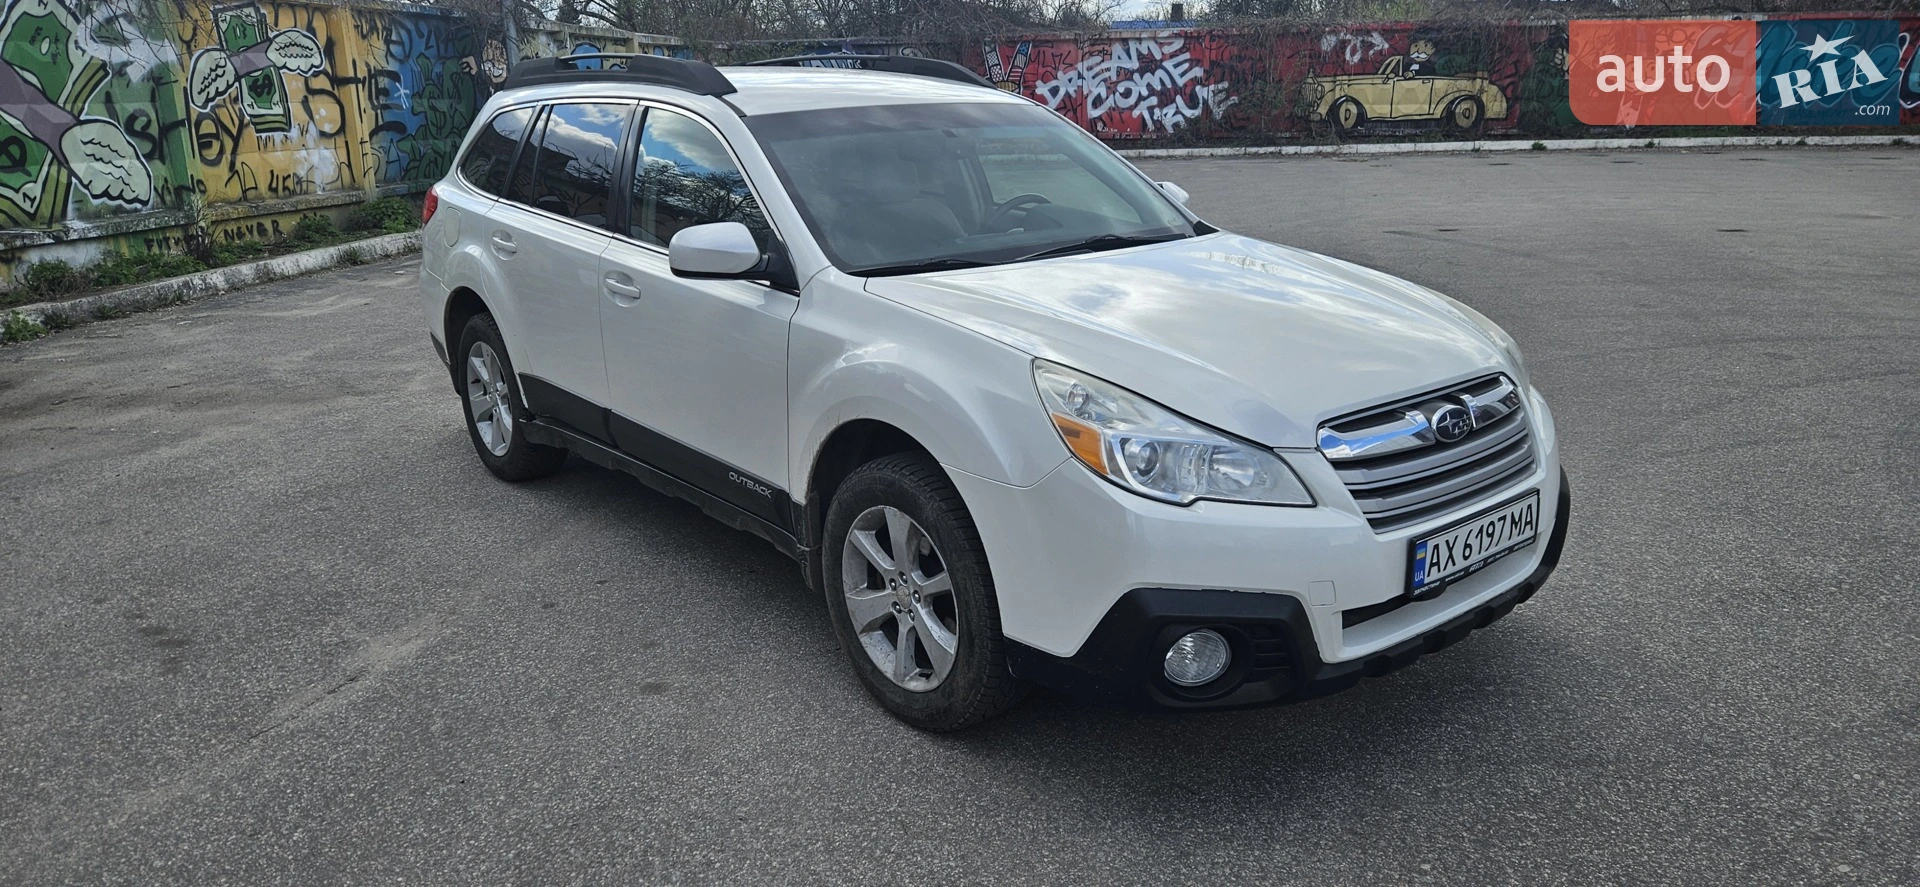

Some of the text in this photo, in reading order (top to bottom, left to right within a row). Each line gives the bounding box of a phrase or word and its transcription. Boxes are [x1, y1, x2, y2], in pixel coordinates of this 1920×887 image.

[1035, 36, 1184, 109] DREAMS
[1087, 52, 1203, 119] COME
[1132, 81, 1239, 133] TRUE
[729, 472, 772, 498] OUTBACK
[1427, 503, 1534, 578] AX 6197 MA
[1414, 570, 1424, 582] UA
